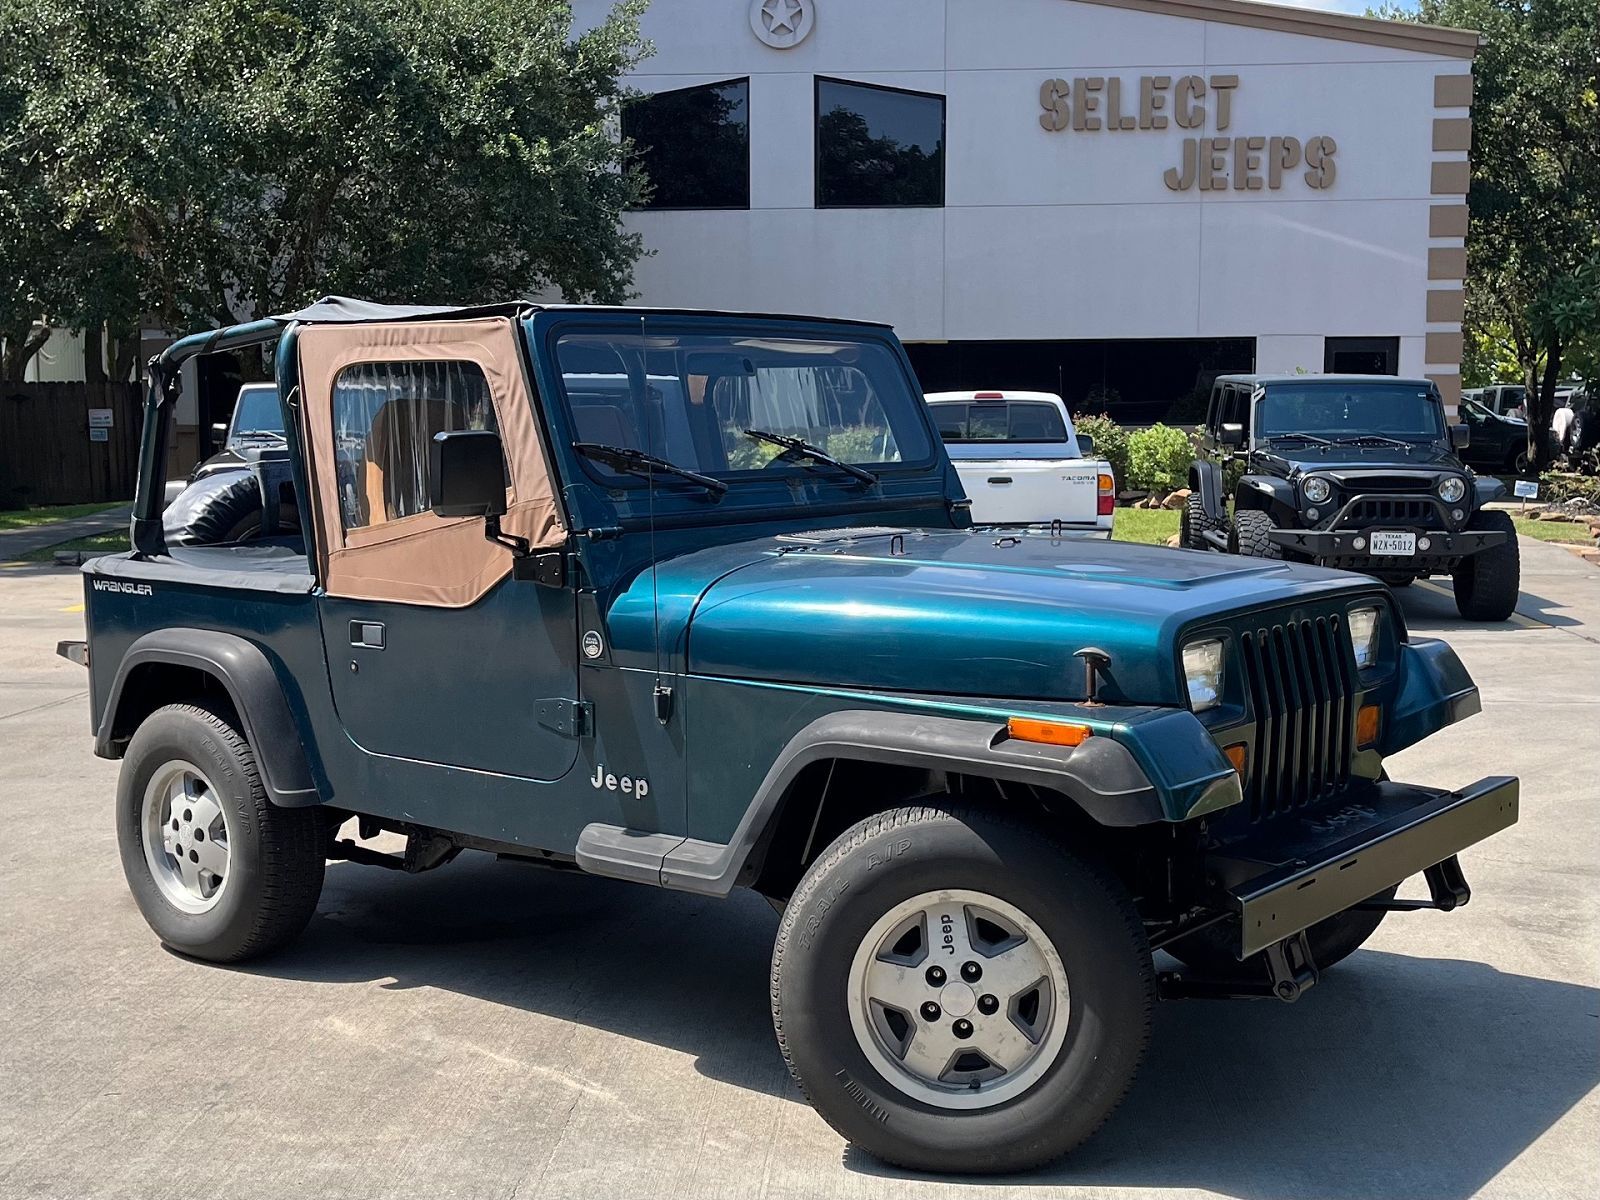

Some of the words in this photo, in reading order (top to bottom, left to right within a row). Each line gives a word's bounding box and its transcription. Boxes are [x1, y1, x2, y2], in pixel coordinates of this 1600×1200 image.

[1039, 75, 1239, 132] SELECT
[1163, 136, 1337, 190] JEEPS
[93, 579, 153, 596] WRANGLER
[591, 764, 649, 800] Jeep
[800, 873, 850, 952] TRAIL
[866, 838, 913, 872] A/P
[940, 914, 955, 955] Jeep
